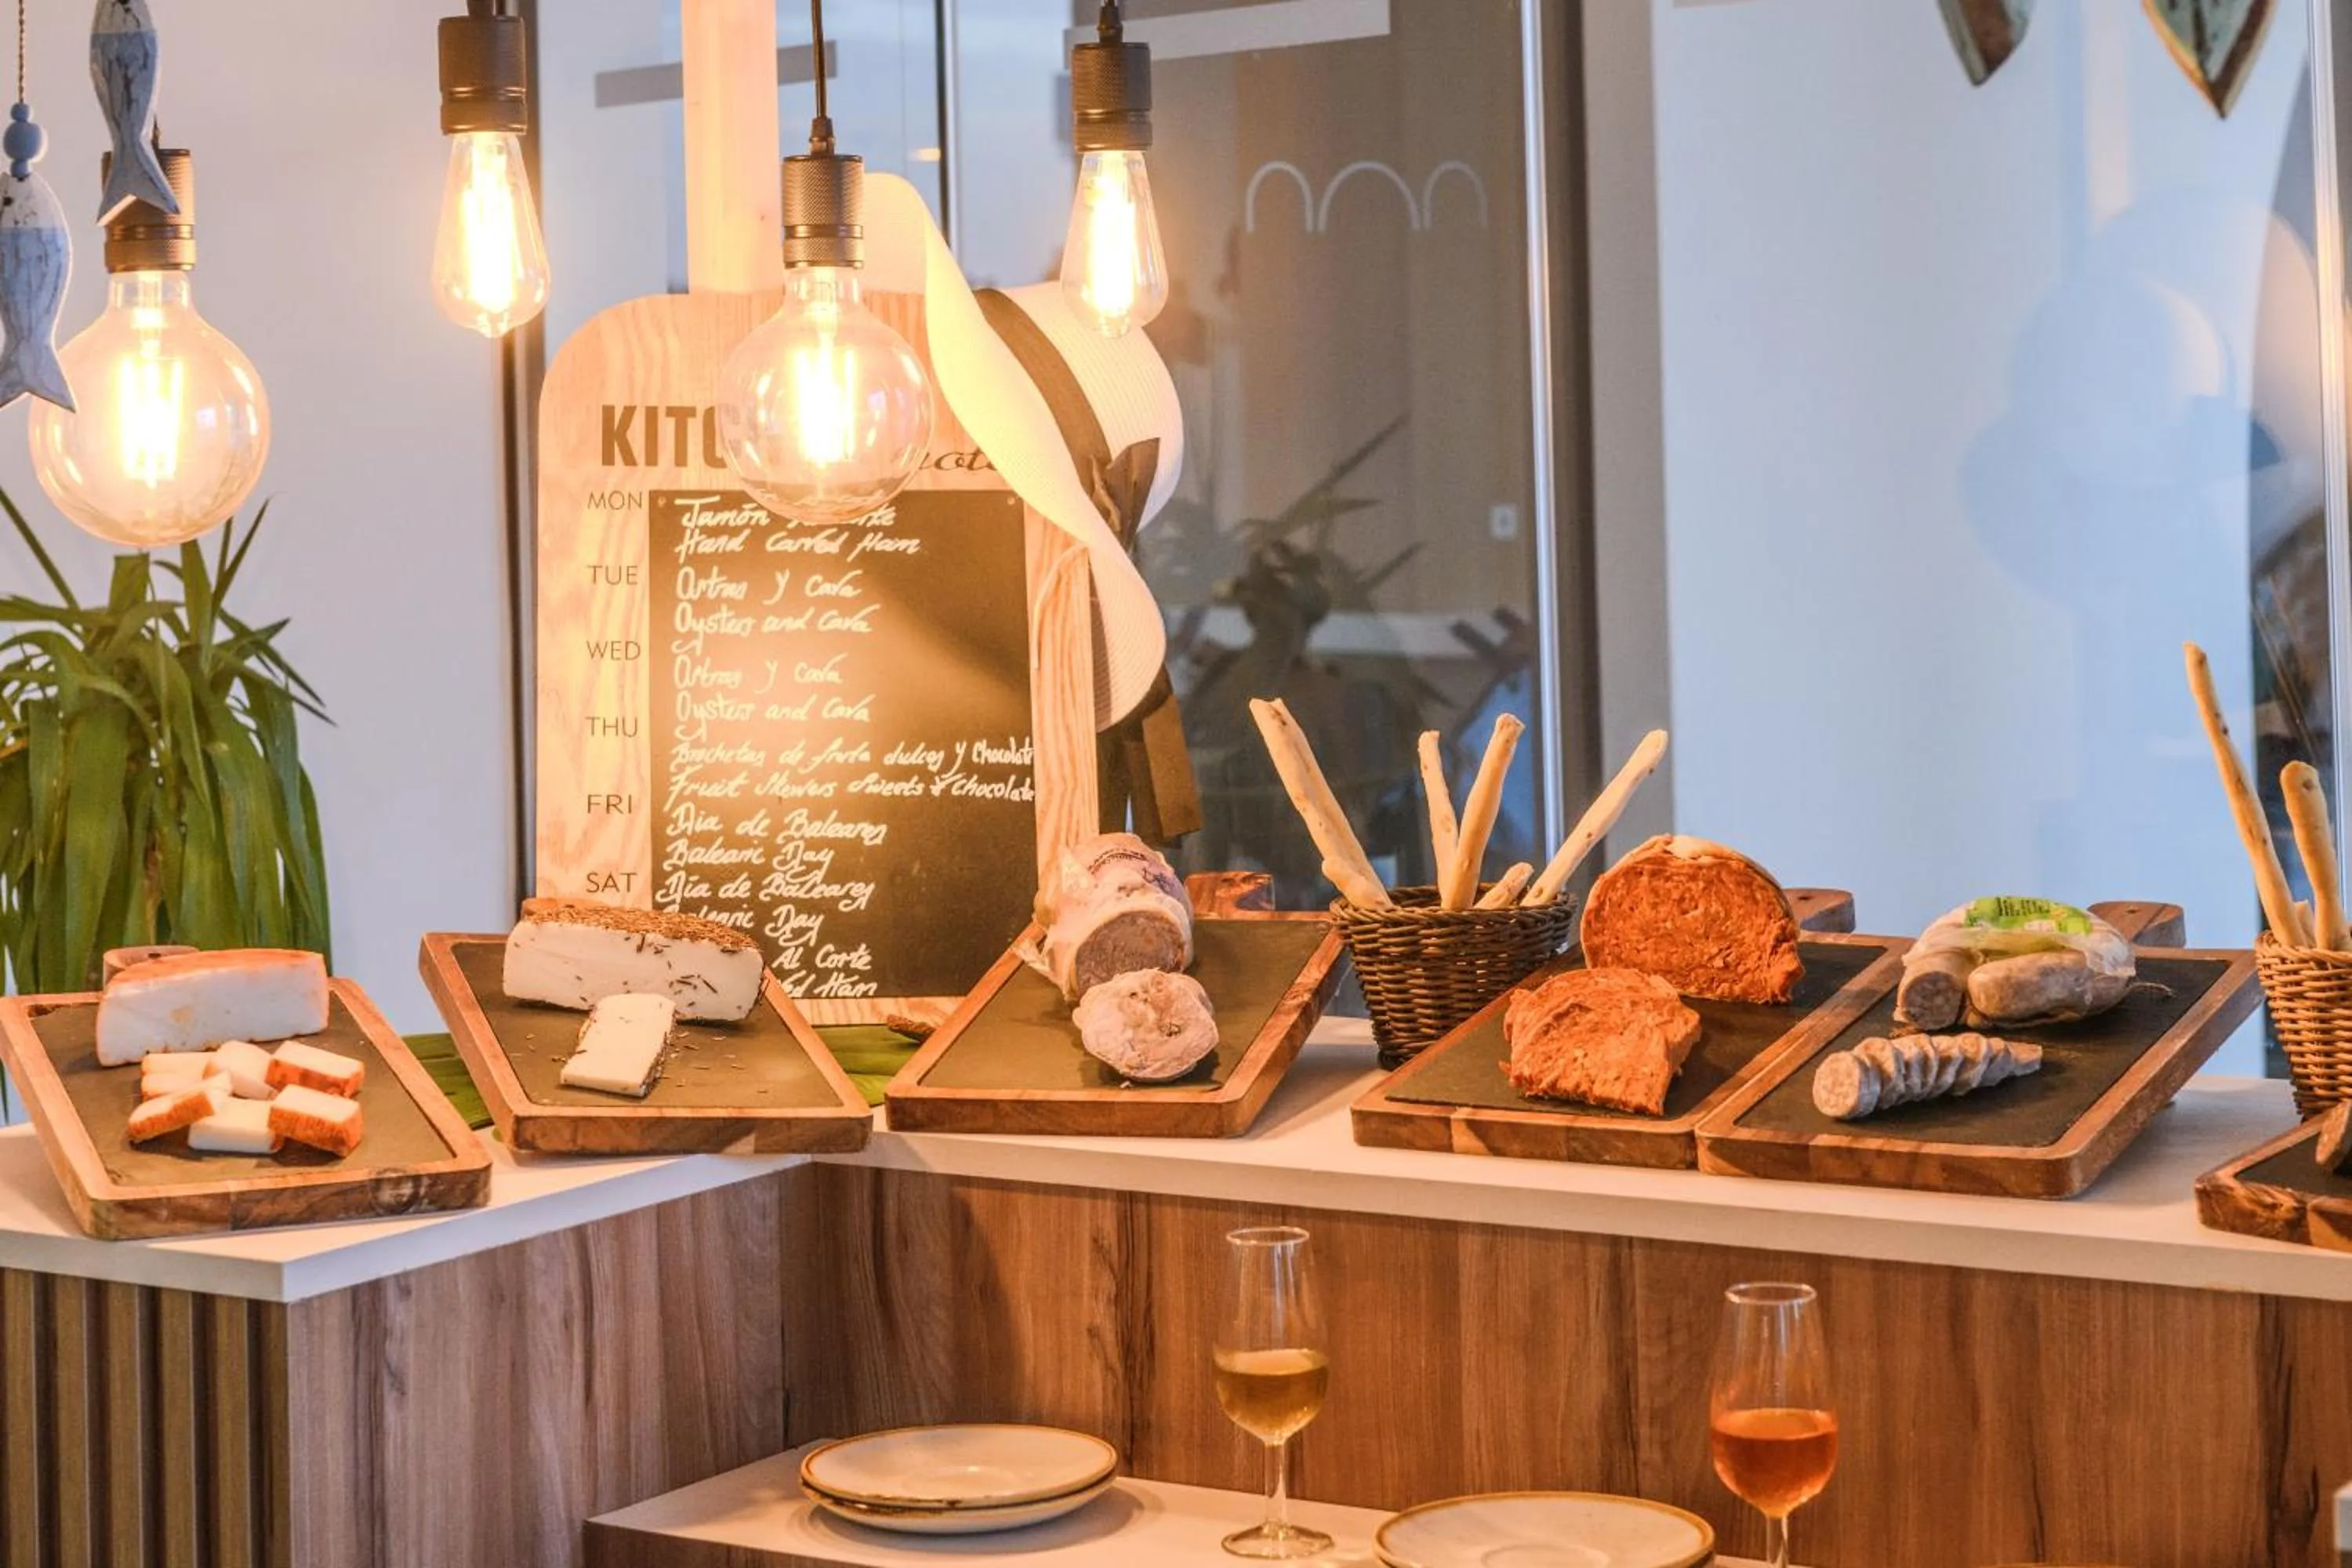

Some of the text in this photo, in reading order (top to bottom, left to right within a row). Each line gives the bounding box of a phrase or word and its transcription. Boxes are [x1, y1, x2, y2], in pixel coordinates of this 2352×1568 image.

[601, 404, 729, 467] KITC
[587, 490, 643, 510] MON
[674, 528, 920, 564] Hand Carved Ham
[588, 564, 639, 585] TUE
[761, 607, 815, 633] and
[586, 640, 641, 660] WED
[764, 693, 818, 721] and
[586, 717, 638, 738] THU
[663, 764, 750, 811] Fruit
[587, 793, 633, 815] FRI
[735, 808, 771, 837] de
[775, 808, 887, 846] Baleares
[662, 836, 835, 884] Balearic Day
[586, 872, 638, 893] SAT
[718, 872, 752, 899] de
[758, 872, 875, 913] Baleares
[764, 904, 825, 947] Day
[771, 943, 873, 970] Al Corte
[812, 971, 877, 997] Ham
